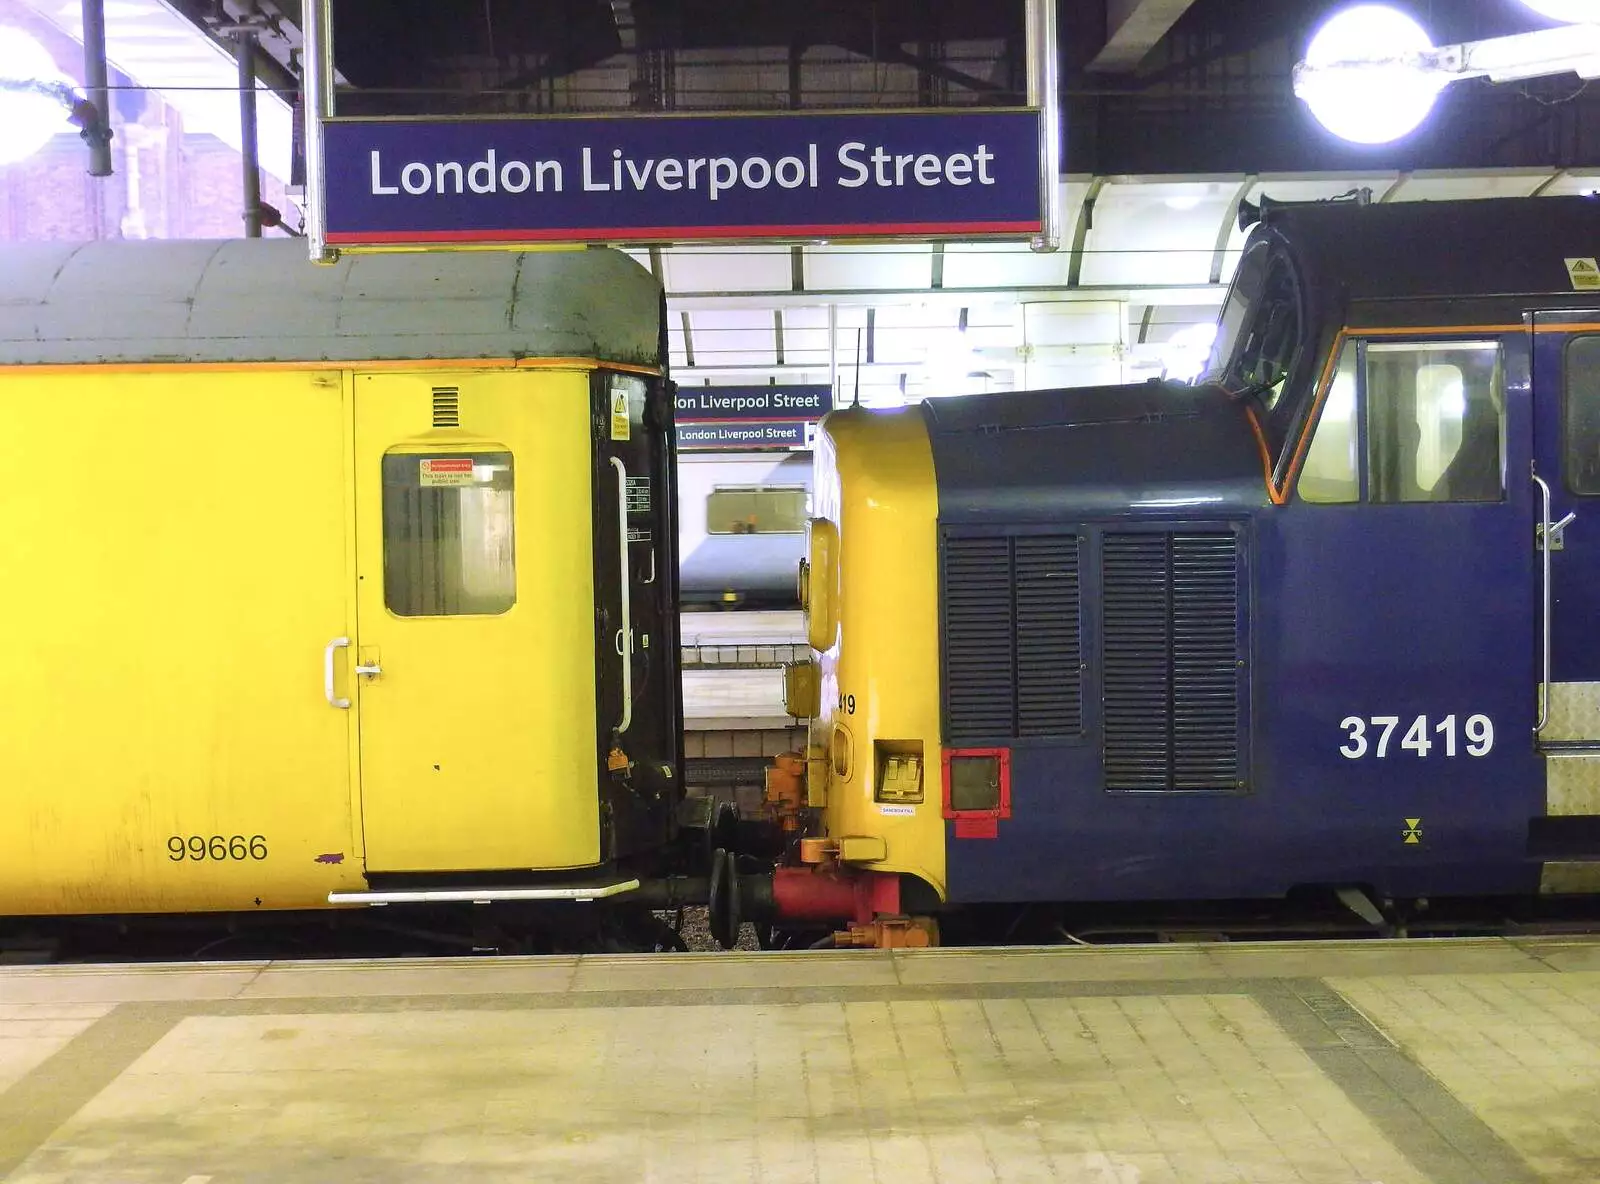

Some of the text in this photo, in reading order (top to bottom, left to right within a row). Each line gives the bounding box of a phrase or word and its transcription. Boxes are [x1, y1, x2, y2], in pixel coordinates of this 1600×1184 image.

[371, 142, 995, 201] London Liverpool Street
[700, 393, 769, 411] Liverpool
[773, 393, 820, 408] Street
[679, 428, 797, 441] London Liverpool Street
[1339, 714, 1495, 759] 37419
[167, 835, 268, 861] 99666
